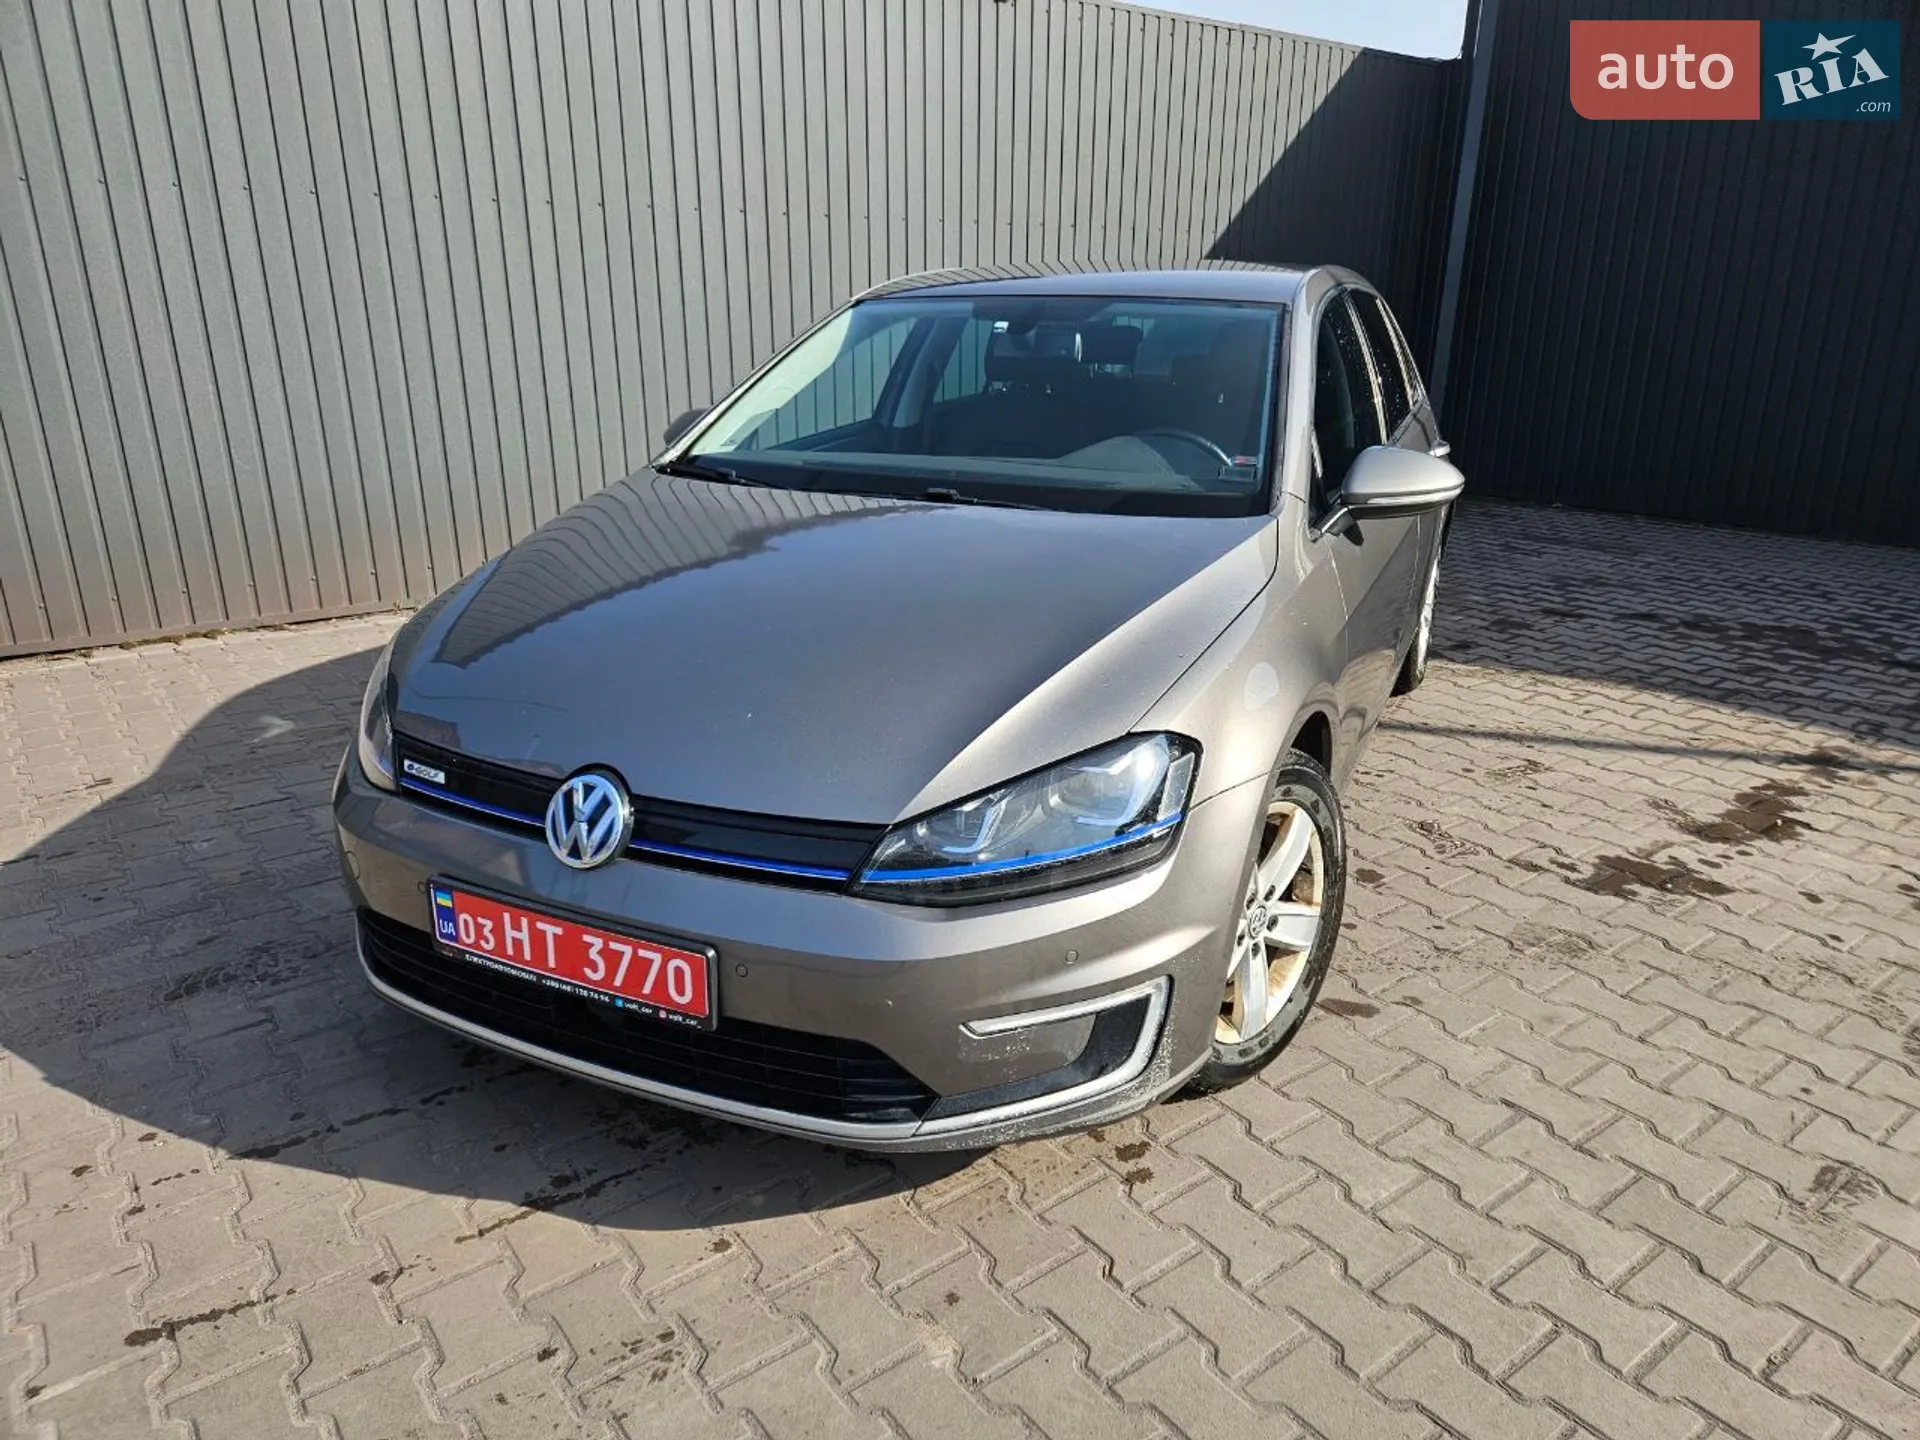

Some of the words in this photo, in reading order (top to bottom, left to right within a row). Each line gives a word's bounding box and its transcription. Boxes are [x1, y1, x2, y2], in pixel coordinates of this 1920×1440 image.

[439, 918, 456, 936] UA
[458, 913, 495, 951] 03
[503, 911, 563, 969] HT
[582, 935, 693, 1005] 3770
